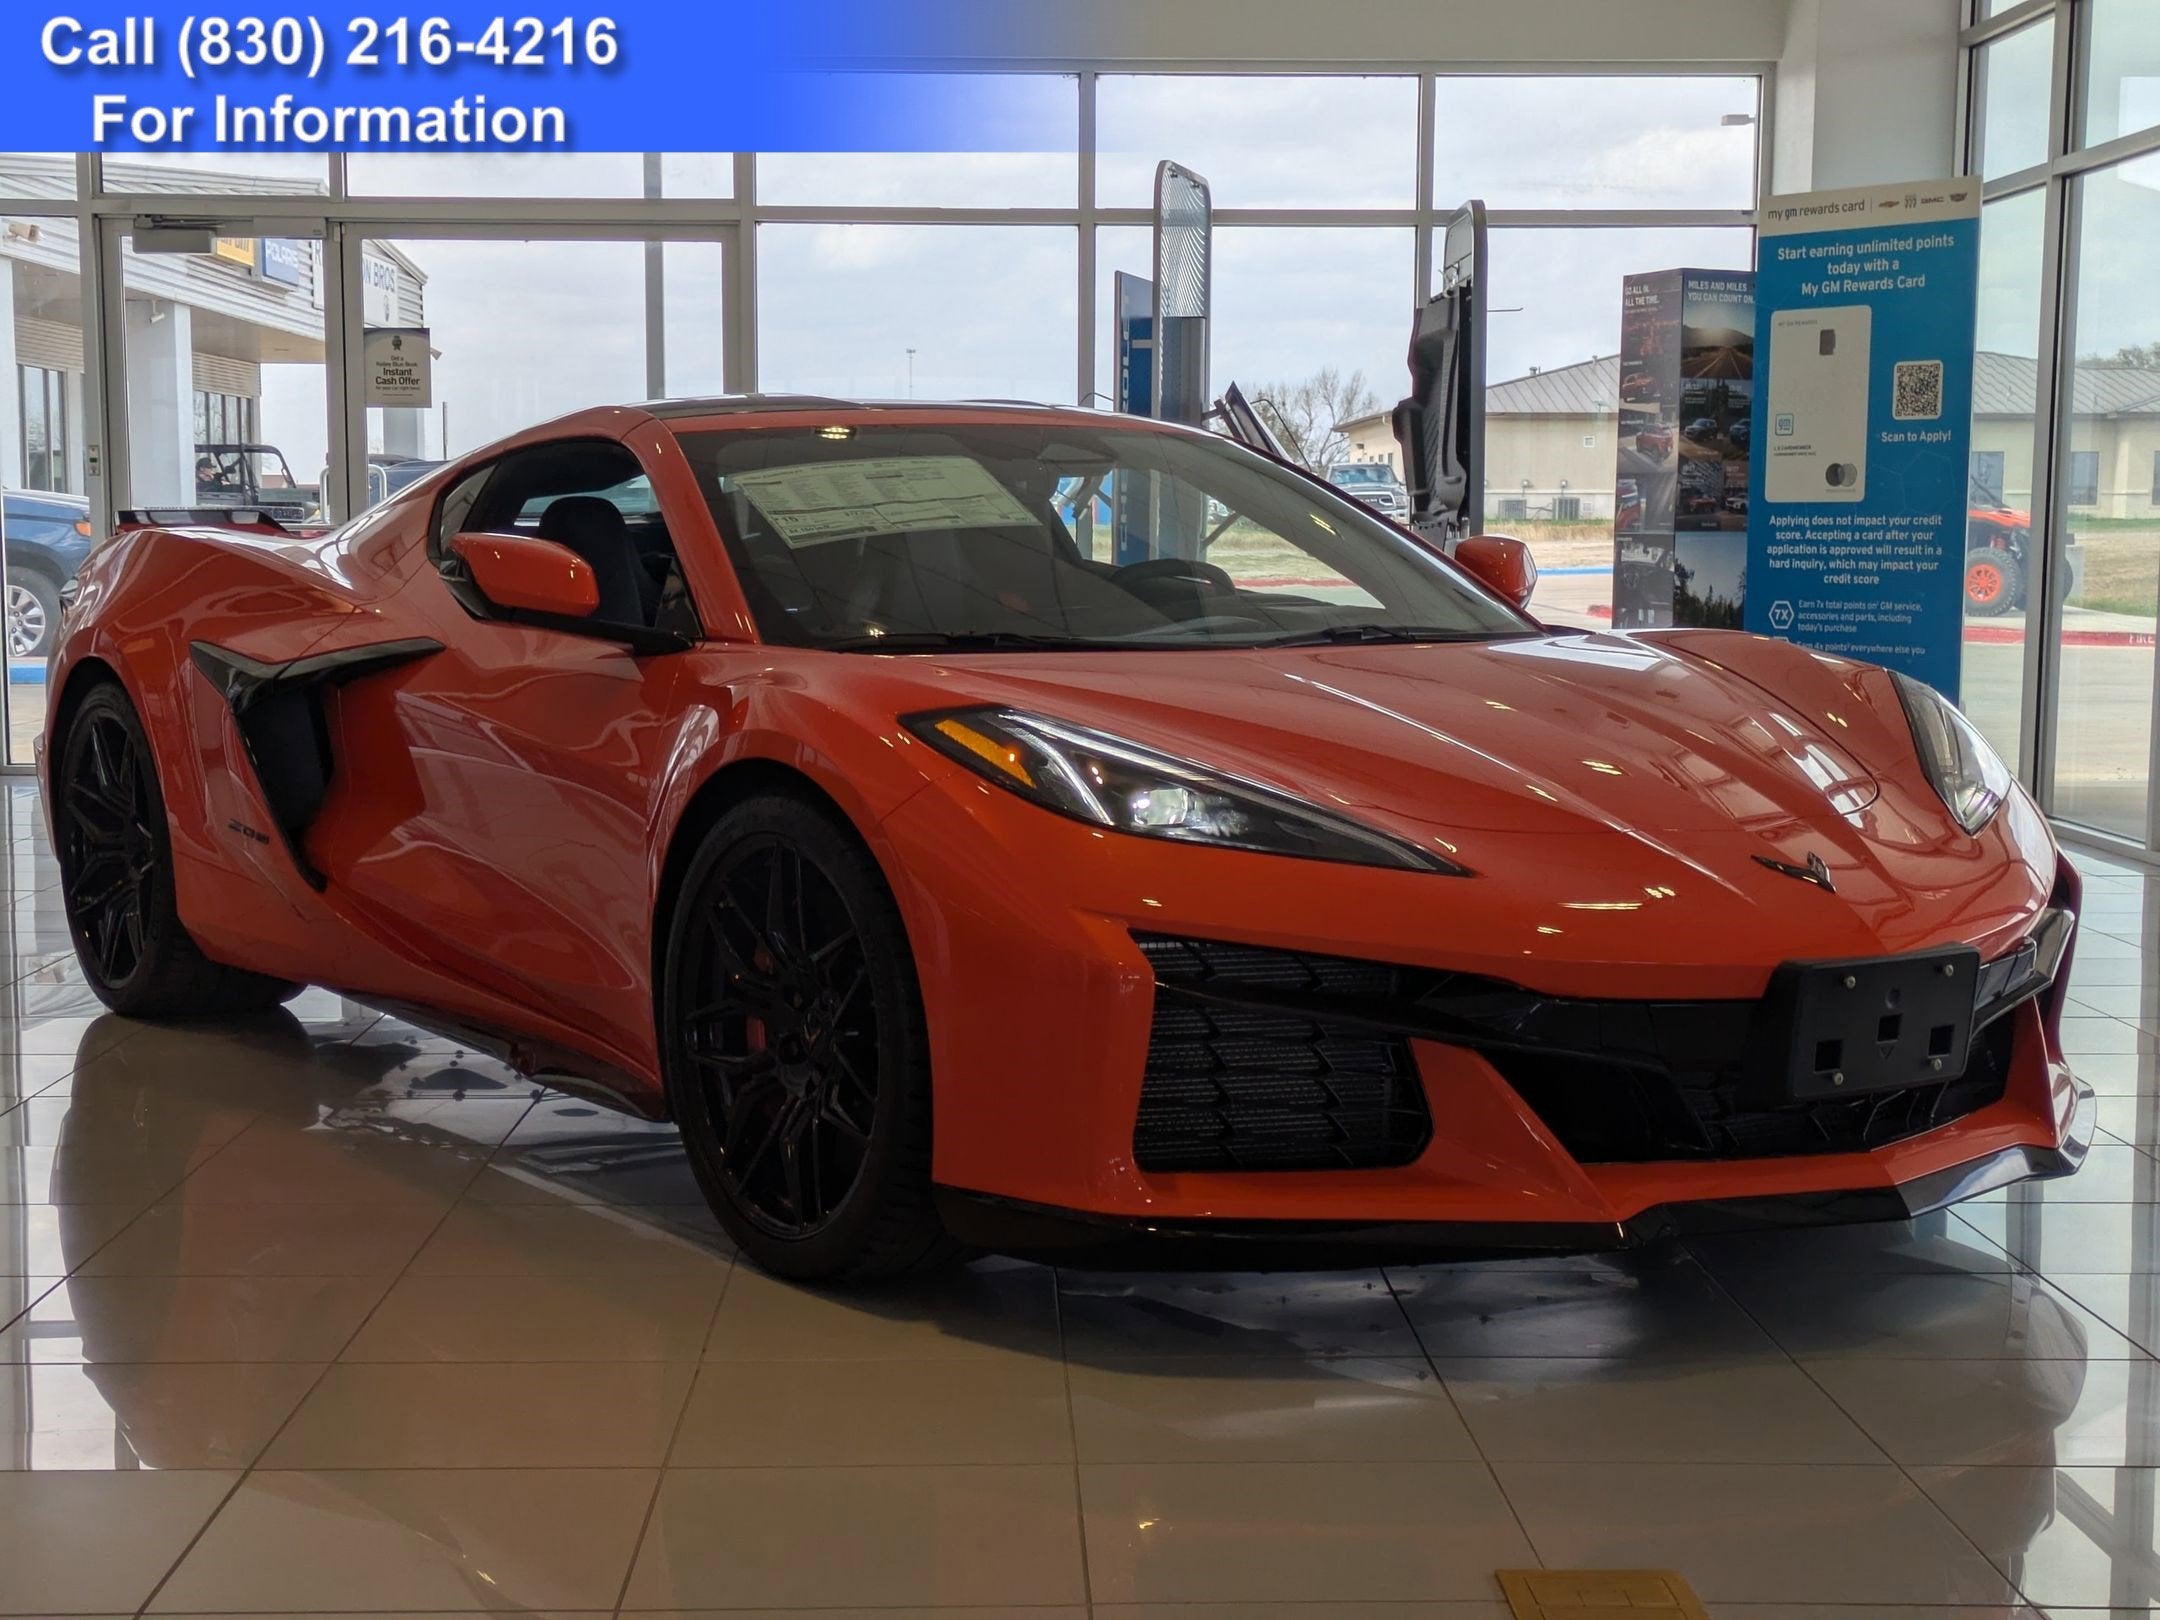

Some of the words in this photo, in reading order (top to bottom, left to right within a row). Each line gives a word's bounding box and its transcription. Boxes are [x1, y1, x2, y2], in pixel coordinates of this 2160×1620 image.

[1768, 209, 1783, 220] my
[1784, 207, 1798, 220] gm
[1799, 202, 1840, 217] rewards
[1842, 199, 1865, 212] card
[1777, 246, 1806, 261] Start
[1809, 243, 1854, 258] earning
[1857, 236, 1913, 254] unlimited
[1916, 234, 1955, 251] points
[1827, 262, 1860, 275] today
[1864, 258, 1889, 272] with
[1892, 259, 1900, 270] a
[373, 262, 395, 293] BROS
[1688, 280, 1710, 290] MILES
[1711, 281, 1725, 291] AND
[1726, 282, 1747, 292] MILES
[1801, 282, 1818, 297] My
[1822, 280, 1840, 294] GM
[1843, 277, 1894, 292] Rewards
[1897, 274, 1926, 288] Card
[1719, 294, 1742, 303] COUNT
[383, 367, 412, 376] Instant
[375, 376, 397, 385] Cash
[398, 376, 420, 385] Offer
[1881, 431, 1905, 442] Scan
[1907, 432, 1917, 442] to
[1919, 431, 1952, 445] Apply!
[1769, 515, 1809, 527] Applying
[1811, 515, 1833, 526] does
[1836, 516, 1851, 526] not
[1854, 515, 1886, 528] impact
[1889, 518, 1910, 528] your
[1913, 515, 1942, 526] credit
[1776, 531, 1803, 540] score.
[1805, 529, 1851, 542] Accepting
[1854, 532, 1860, 540] a
[1862, 530, 1883, 540] card
[1885, 530, 1909, 540] after
[1911, 532, 1933, 543] your
[1767, 544, 1817, 557] application
[1819, 544, 1827, 554] is
[1829, 545, 1873, 557] approved
[1875, 544, 1892, 555] will
[1894, 545, 1922, 555] result
[1924, 545, 1933, 555] in
[1936, 547, 1942, 555] a
[1769, 558, 1790, 569] hard
[1829, 559, 1856, 569] which
[1858, 561, 1879, 572] may
[1881, 560, 1914, 571] impact
[1916, 562, 1939, 573] your
[1824, 573, 1851, 584] credit
[1853, 575, 1879, 584] score
[1798, 600, 1815, 609] Earn
[1816, 600, 1824, 608] 7x
[1825, 600, 1842, 609] total
[1844, 601, 1866, 610] points
[1894, 602, 1922, 612] service,
[1774, 609, 1789, 620] 7X
[1798, 612, 1839, 621] accessories
[1840, 612, 1854, 621] and
[1855, 613, 1876, 623] parts,
[1878, 614, 1912, 624] including
[1797, 623, 1823, 633] today's
[1824, 624, 1857, 633] purchase
[1851, 645, 1893, 654] everywhere
[1894, 646, 1911, 654] else
[1912, 647, 1925, 655] you
